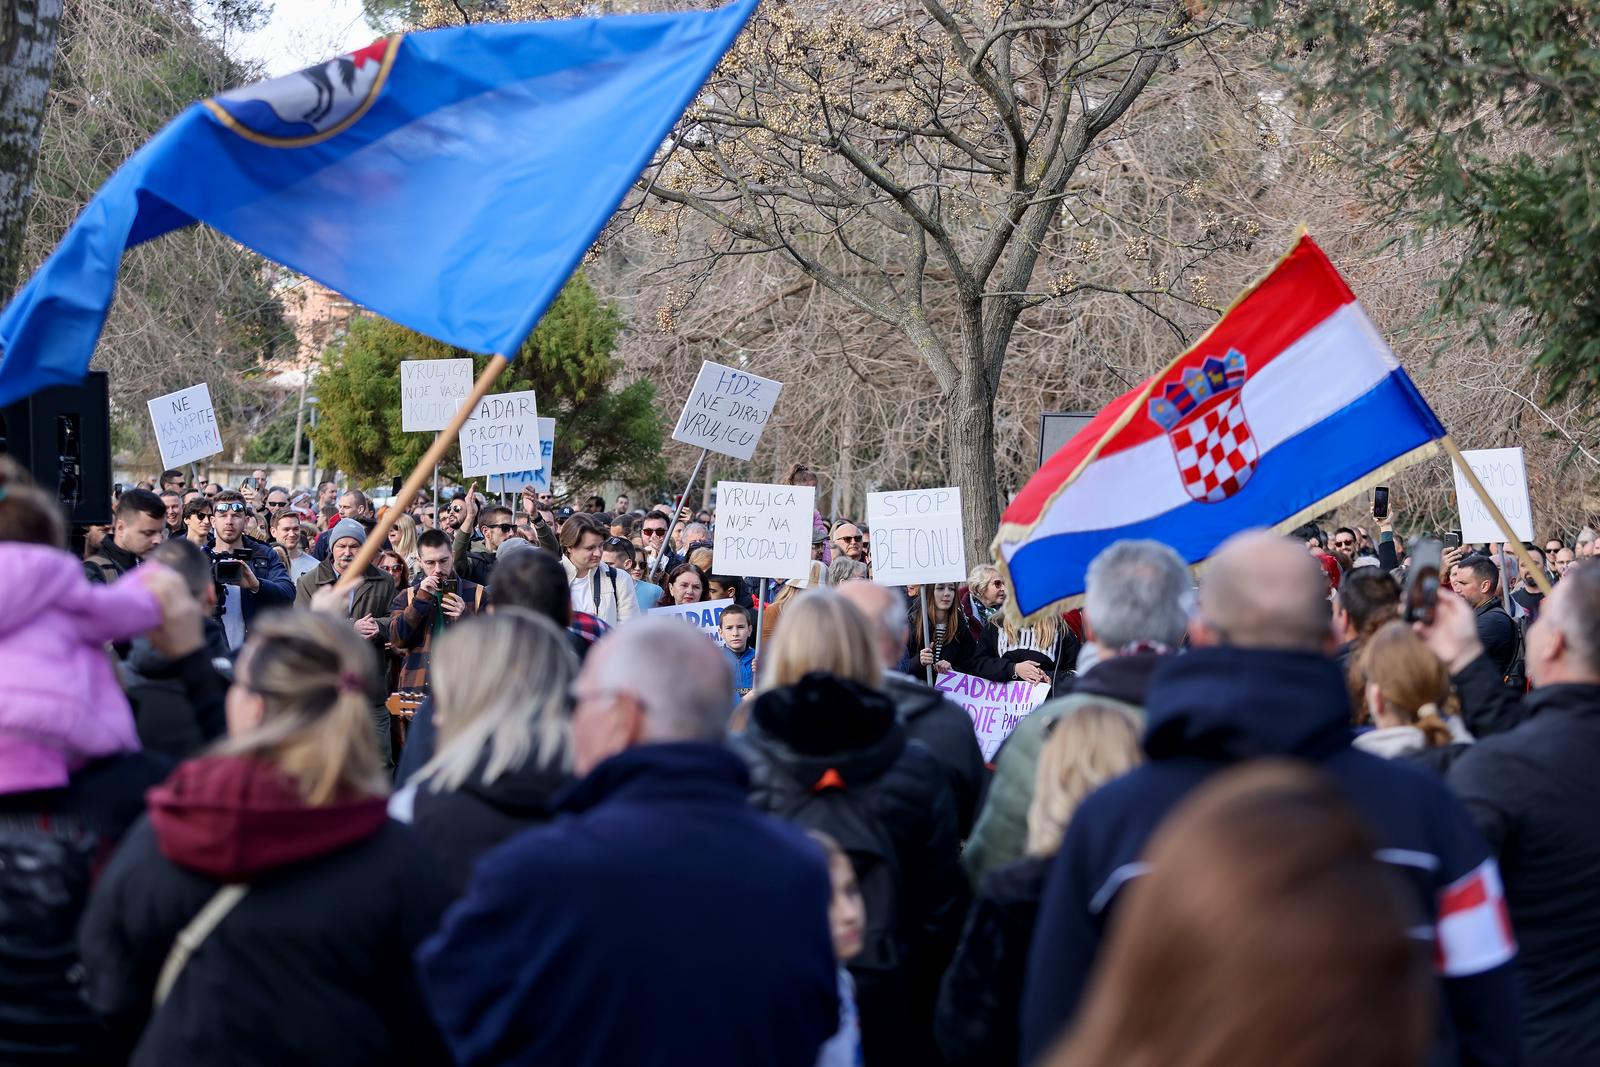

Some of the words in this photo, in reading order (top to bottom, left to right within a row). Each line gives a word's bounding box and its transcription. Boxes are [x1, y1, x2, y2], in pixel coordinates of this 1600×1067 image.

[405, 385, 431, 400] NIJE
[440, 383, 466, 397] VAŠA
[172, 396, 191, 415] NE
[467, 397, 535, 420] ADAR
[696, 392, 724, 412] NE
[728, 401, 768, 425] DIRAJ
[160, 407, 214, 440] KASAPITE
[470, 424, 524, 443] PROTIV
[466, 442, 536, 469] BETONA
[883, 491, 950, 517] STOP
[726, 515, 757, 532] NIJE
[768, 517, 791, 533] NA
[722, 536, 798, 561] PRODAJU
[872, 527, 961, 572] BETONU
[934, 671, 1034, 704] ZADRANI
